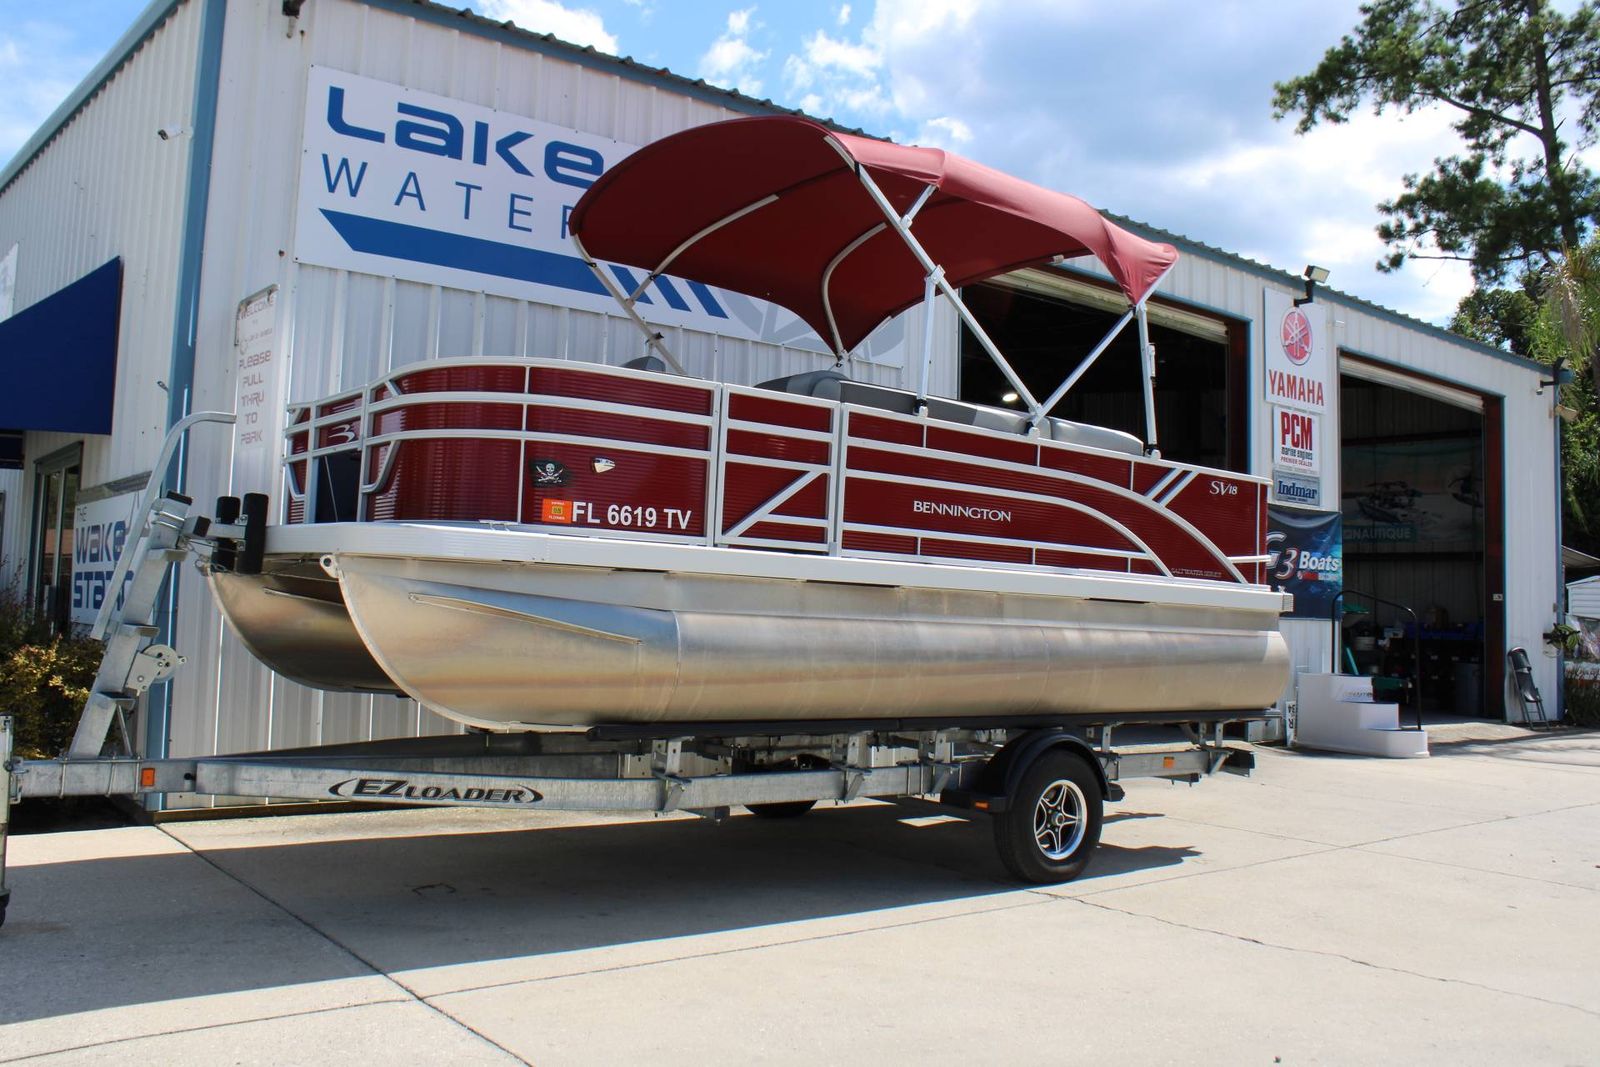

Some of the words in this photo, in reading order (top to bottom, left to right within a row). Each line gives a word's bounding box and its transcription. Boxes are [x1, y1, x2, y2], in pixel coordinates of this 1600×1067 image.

[243, 372, 263, 388] PULL
[1269, 369, 1324, 406] YAMAHA
[241, 390, 265, 407] THRU
[245, 412, 258, 425] TO
[1281, 411, 1313, 451] PCM
[1210, 480, 1238, 496] SV18
[1278, 480, 1317, 499] Indmar
[572, 501, 600, 523] FL
[607, 504, 657, 528] 6619
[663, 508, 691, 530] TV
[913, 501, 1011, 522] BENNINGTON
[1299, 550, 1339, 571] Boats
